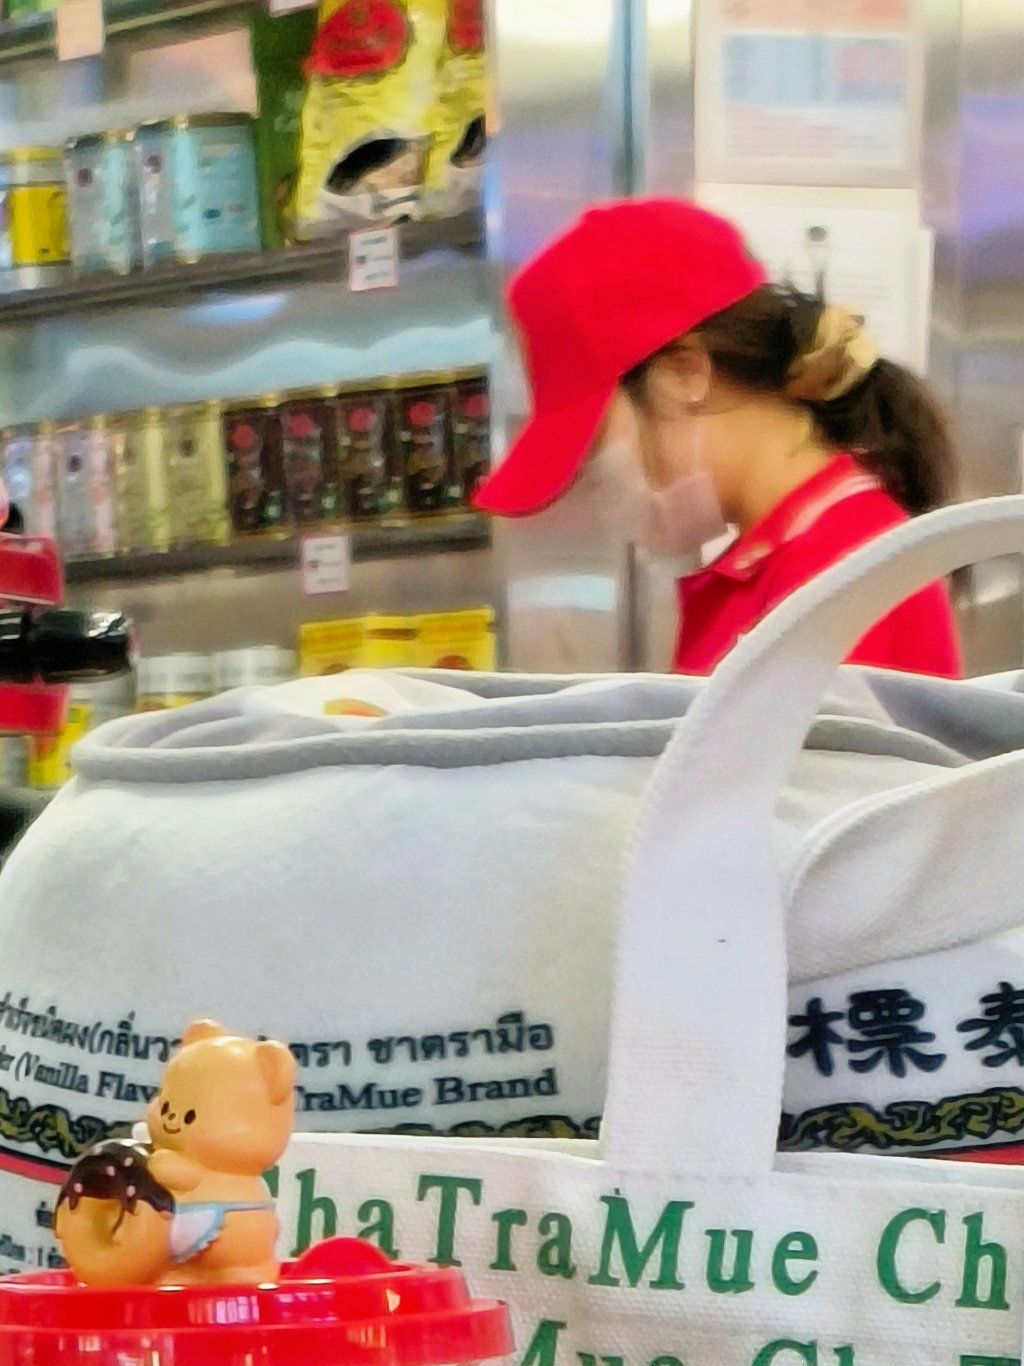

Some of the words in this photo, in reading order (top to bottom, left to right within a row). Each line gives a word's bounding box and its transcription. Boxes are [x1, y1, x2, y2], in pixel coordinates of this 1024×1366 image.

[367, 1011, 555, 1064] ชาตรามือ
[433, 1069, 559, 1105] Brand
[261, 1165, 818, 1297] haTraMue
[876, 1208, 1010, 1310] Ch
